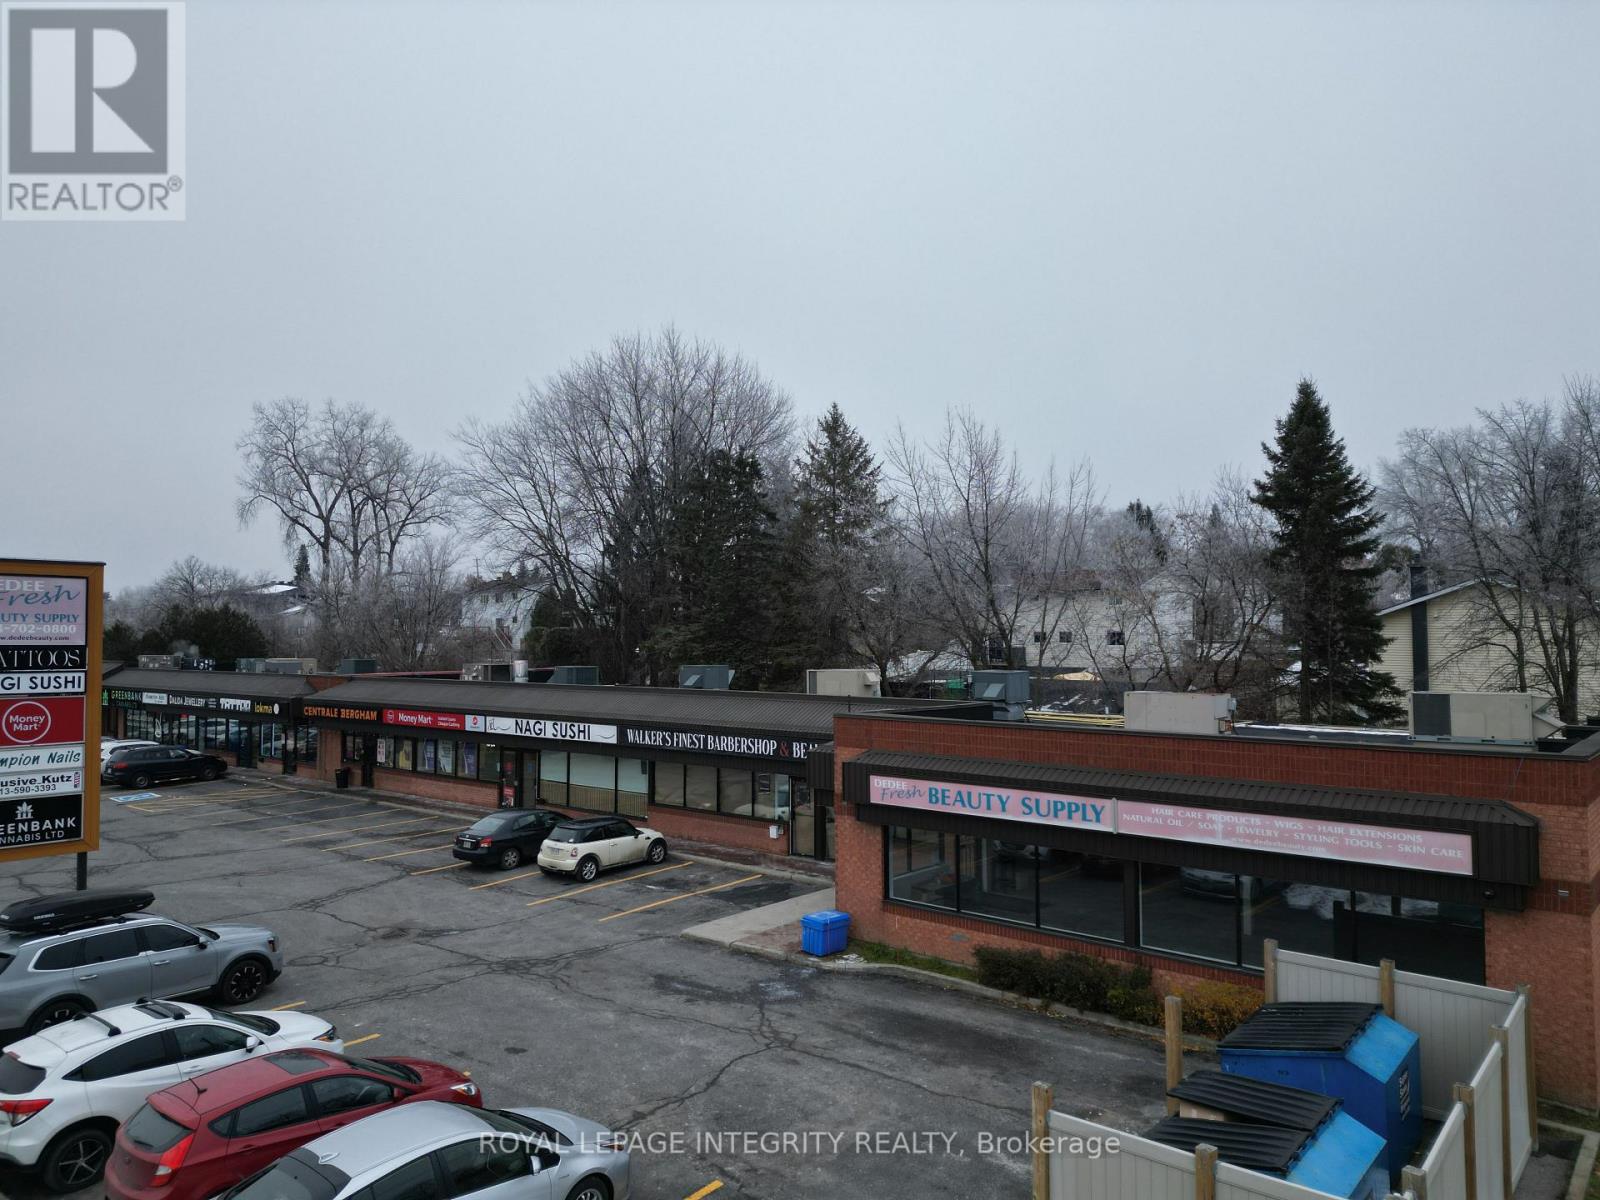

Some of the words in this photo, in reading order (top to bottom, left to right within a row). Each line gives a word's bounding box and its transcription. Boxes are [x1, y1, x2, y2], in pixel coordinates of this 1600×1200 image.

[34, 613, 79, 624] SUPPLY
[29, 675, 82, 690] SUSHI
[111, 690, 142, 701] GREENBANK
[184, 696, 206, 707] JEWELLERY
[220, 698, 251, 713] TATTOO
[9, 714, 45, 724] Money
[303, 706, 339, 718] CENTRALE
[340, 708, 378, 720] BERGHAM
[398, 712, 418, 725] Money
[418, 714, 433, 725] Mart
[13, 723, 39, 732] Mart
[515, 719, 547, 737] NAGI
[552, 721, 591, 741] SUSHI
[626, 728, 672, 747] WALKER'S
[673, 731, 705, 750] FINEST
[707, 735, 777, 756] BARBERSHOP
[779, 741, 789, 758] &
[47, 751, 81, 764] Nails
[874, 778, 908, 791] DEDEE
[880, 785, 926, 801] Fresh
[928, 786, 1010, 813] BEAUTY
[1022, 796, 1106, 824] SUPPLY
[1152, 807, 1175, 817] HAIR
[1178, 809, 1202, 819] CARE
[1206, 813, 1261, 826] PRODUCTS
[1274, 820, 1303, 830] WIGS
[1317, 825, 1345, 836] HAIR
[1350, 828, 1423, 844] EXTENSIONS
[45, 830, 65, 840] LTD
[1122, 813, 1164, 825] NATURAL
[1167, 818, 1185, 828] OIL
[1235, 826, 1280, 837] JEWELRY
[1294, 832, 1339, 845] STYLING
[1344, 837, 1383, 850] TOOLS
[1397, 843, 1426, 855] SKIN
[1430, 848, 1464, 859] CARE
